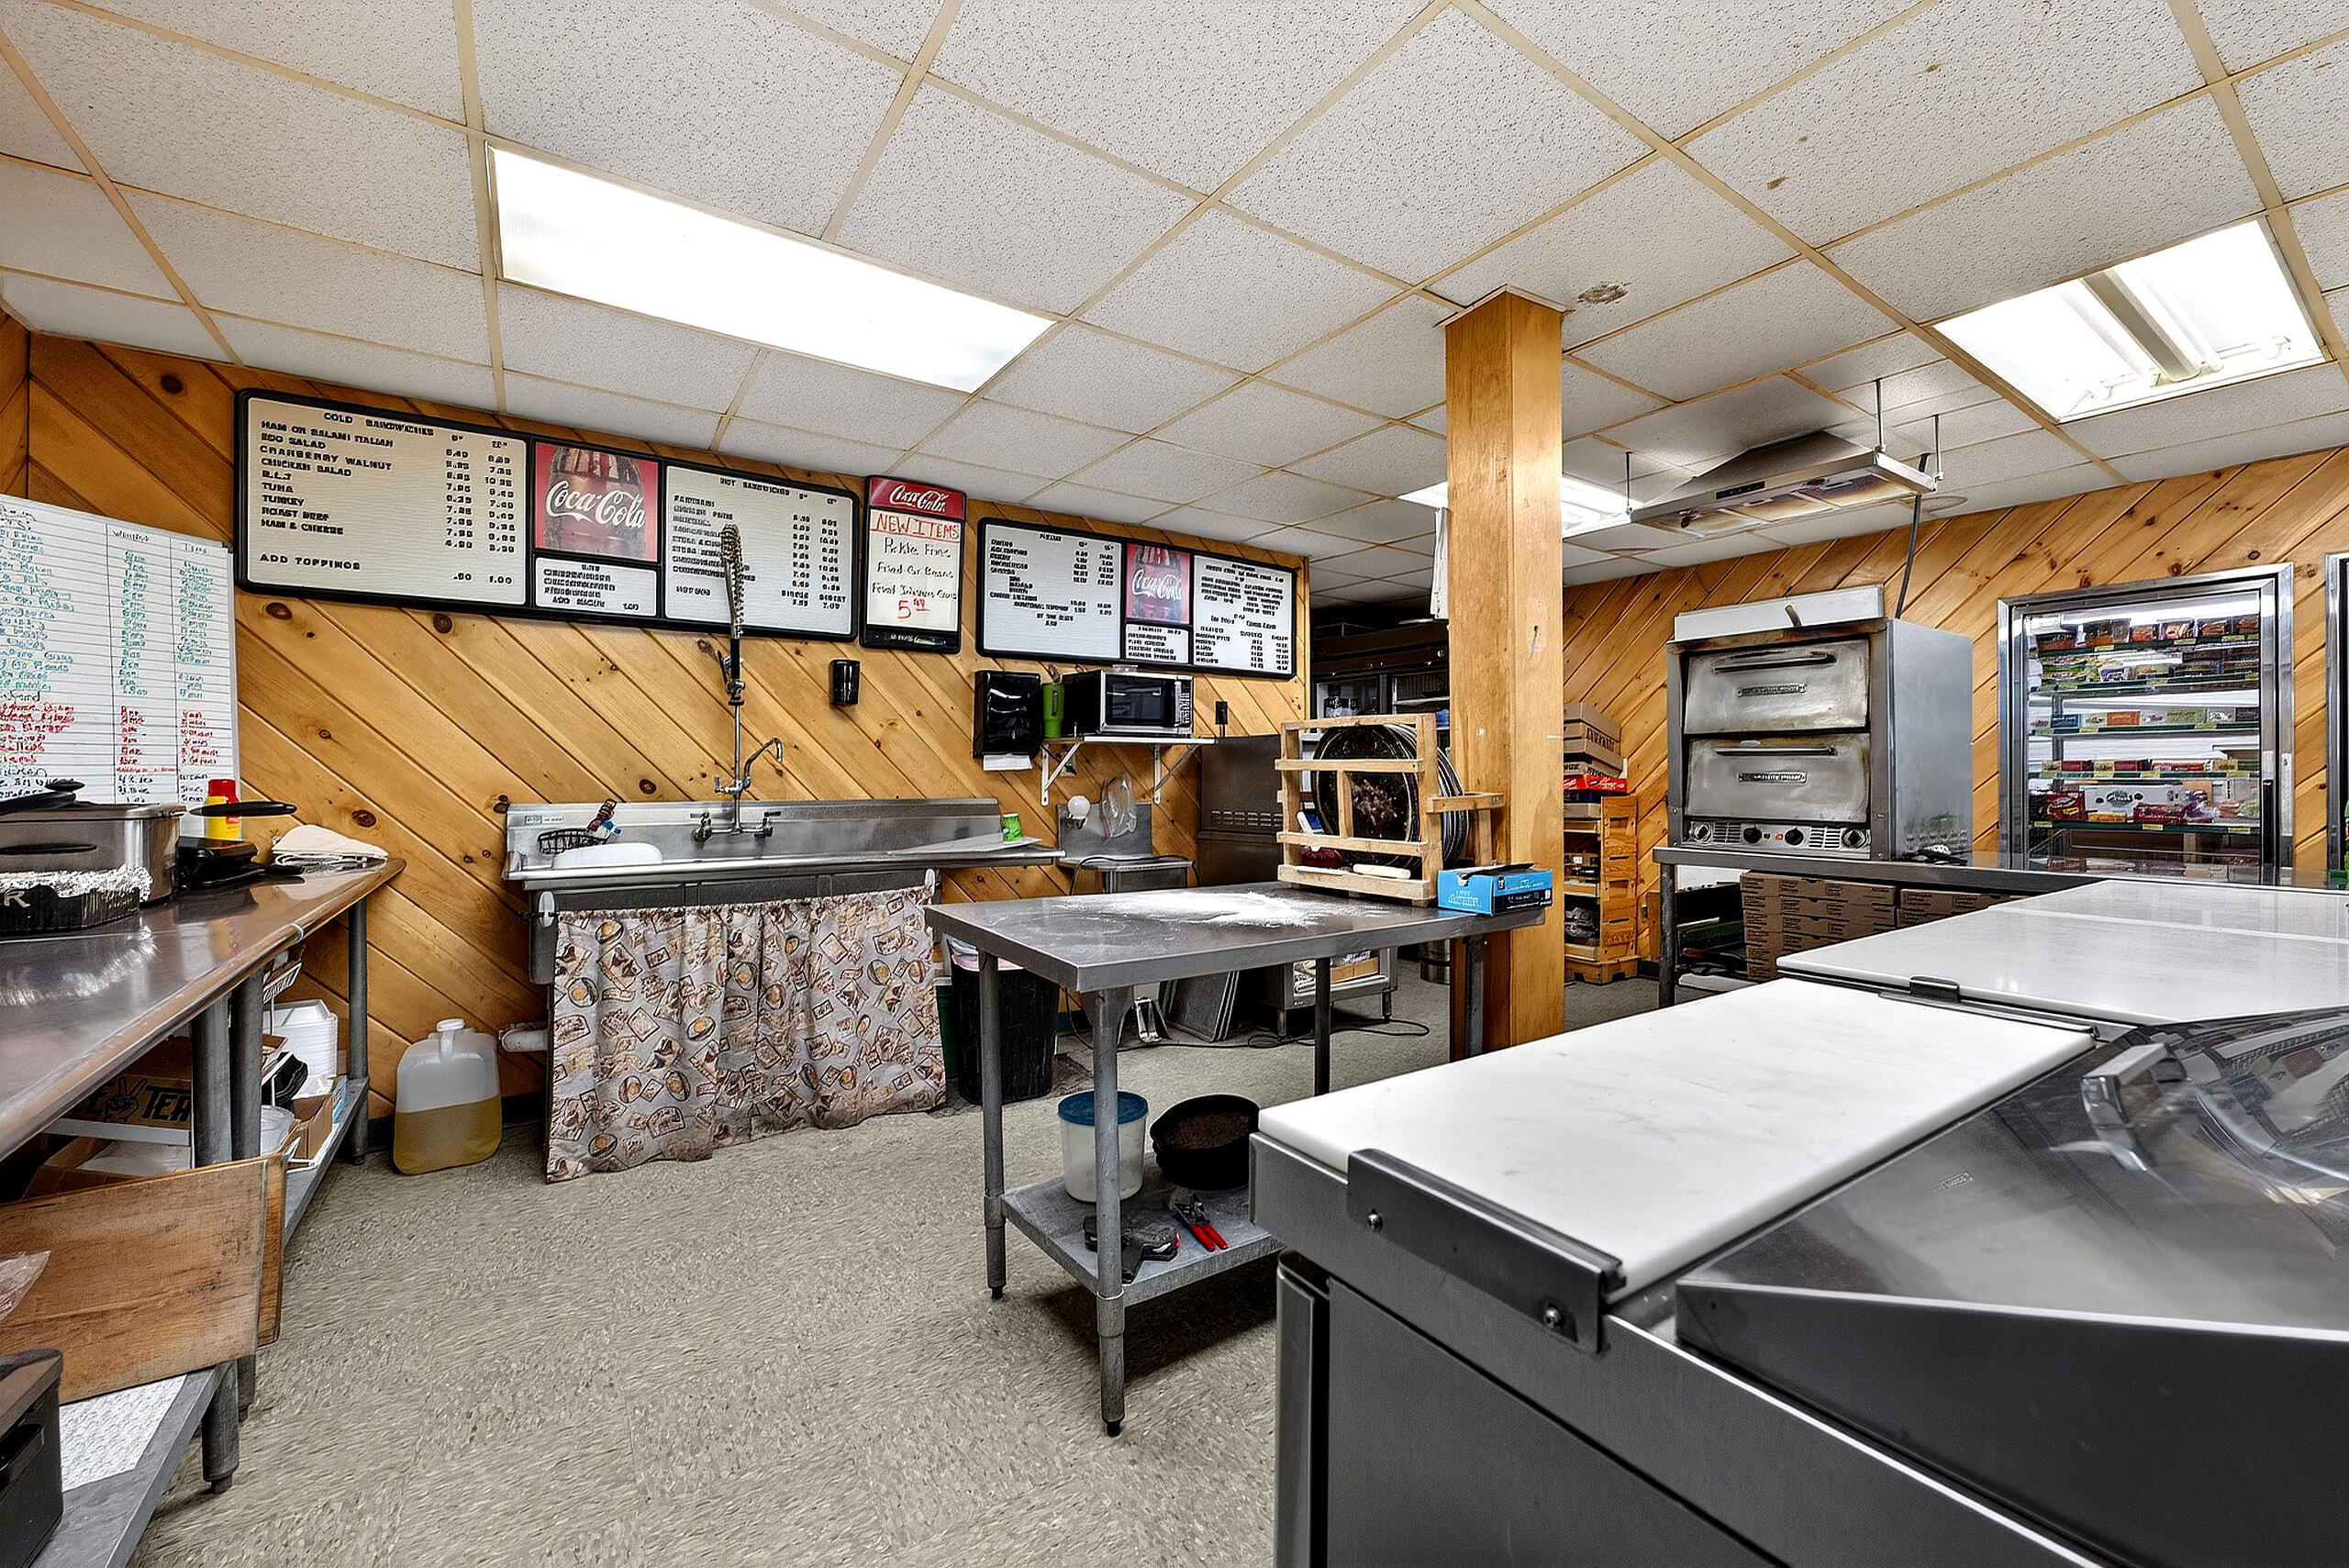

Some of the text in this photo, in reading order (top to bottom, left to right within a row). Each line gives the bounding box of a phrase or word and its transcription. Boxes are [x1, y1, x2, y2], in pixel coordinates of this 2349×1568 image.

[323, 413, 353, 424] COLD
[546, 480, 645, 528] Coca-Cola
[889, 484, 950, 512] Coca-Cola
[876, 514, 960, 539] NEW ITEMS
[260, 553, 361, 570] ADD TOPPINGS
